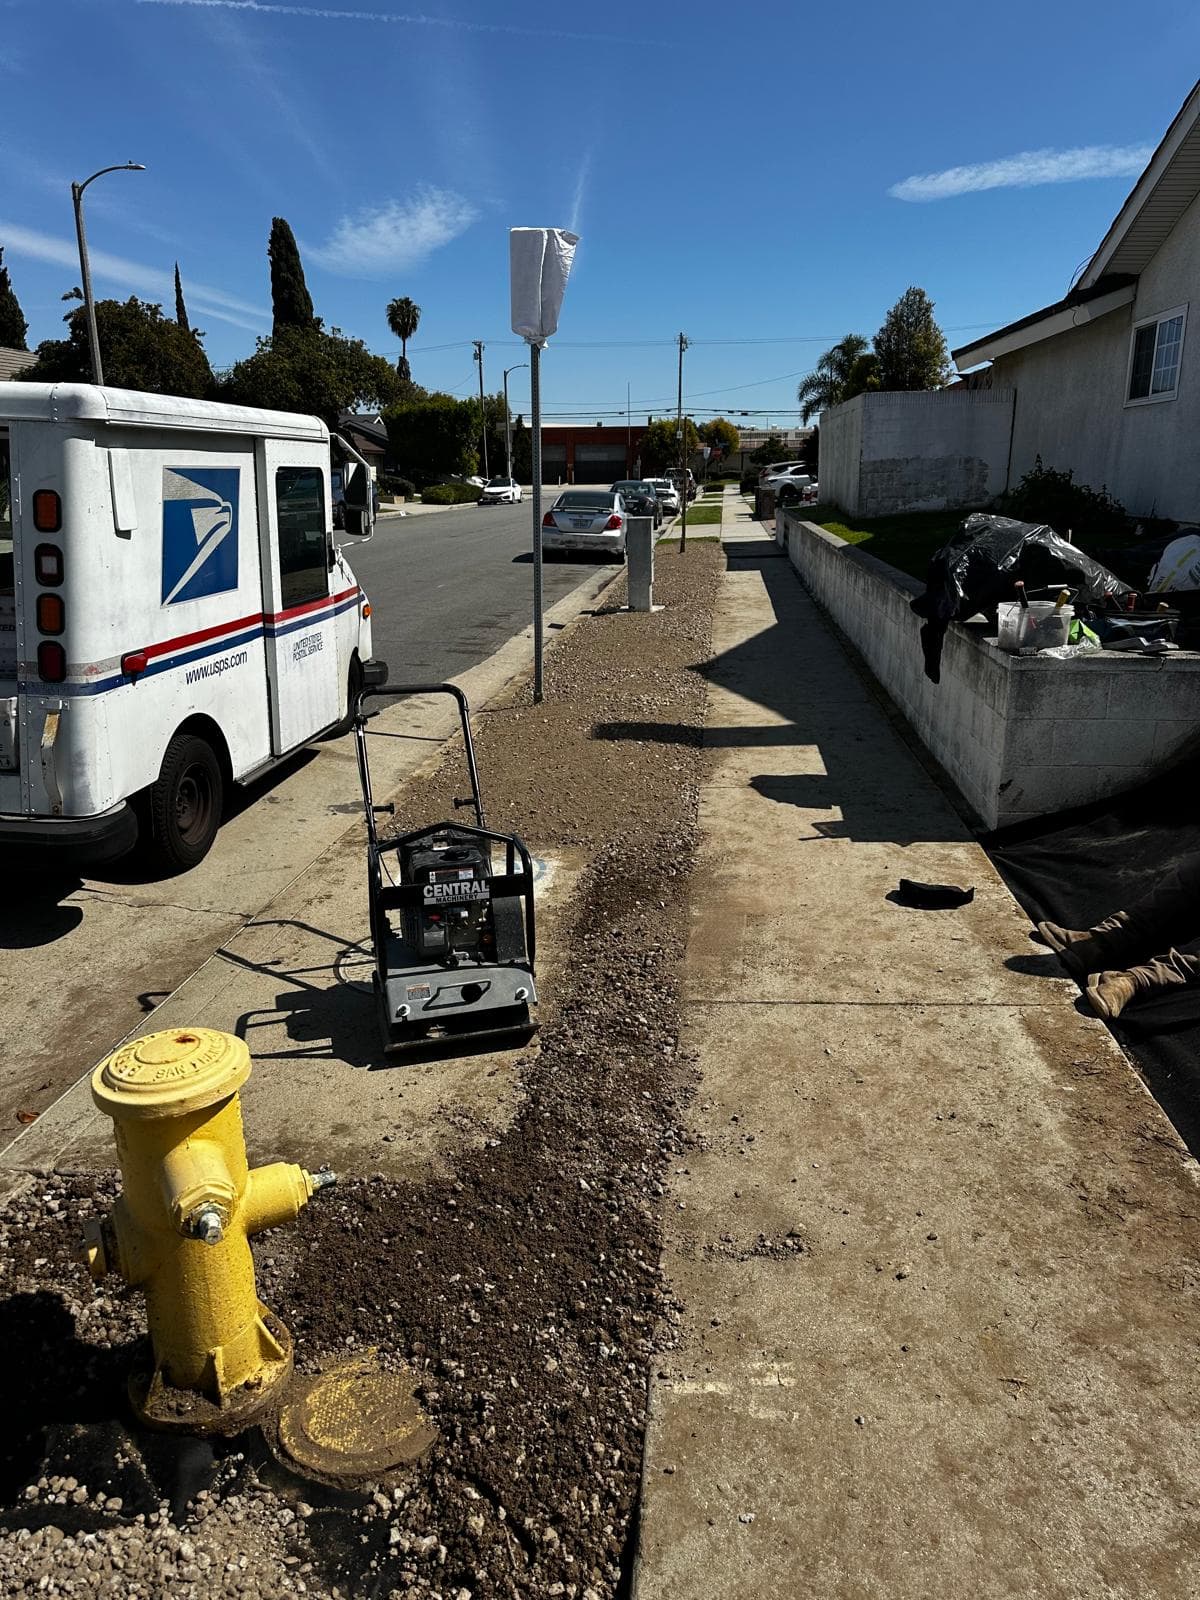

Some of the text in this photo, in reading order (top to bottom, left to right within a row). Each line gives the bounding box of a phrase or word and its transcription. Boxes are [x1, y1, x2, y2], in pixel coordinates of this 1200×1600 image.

[292, 641, 324, 662] POSTAL SERVICE
[293, 636, 309, 652] UNITED
[185, 651, 248, 685] www.usps.com
[423, 880, 490, 898] CENTRAL
[435, 893, 478, 904] MACHINERY
